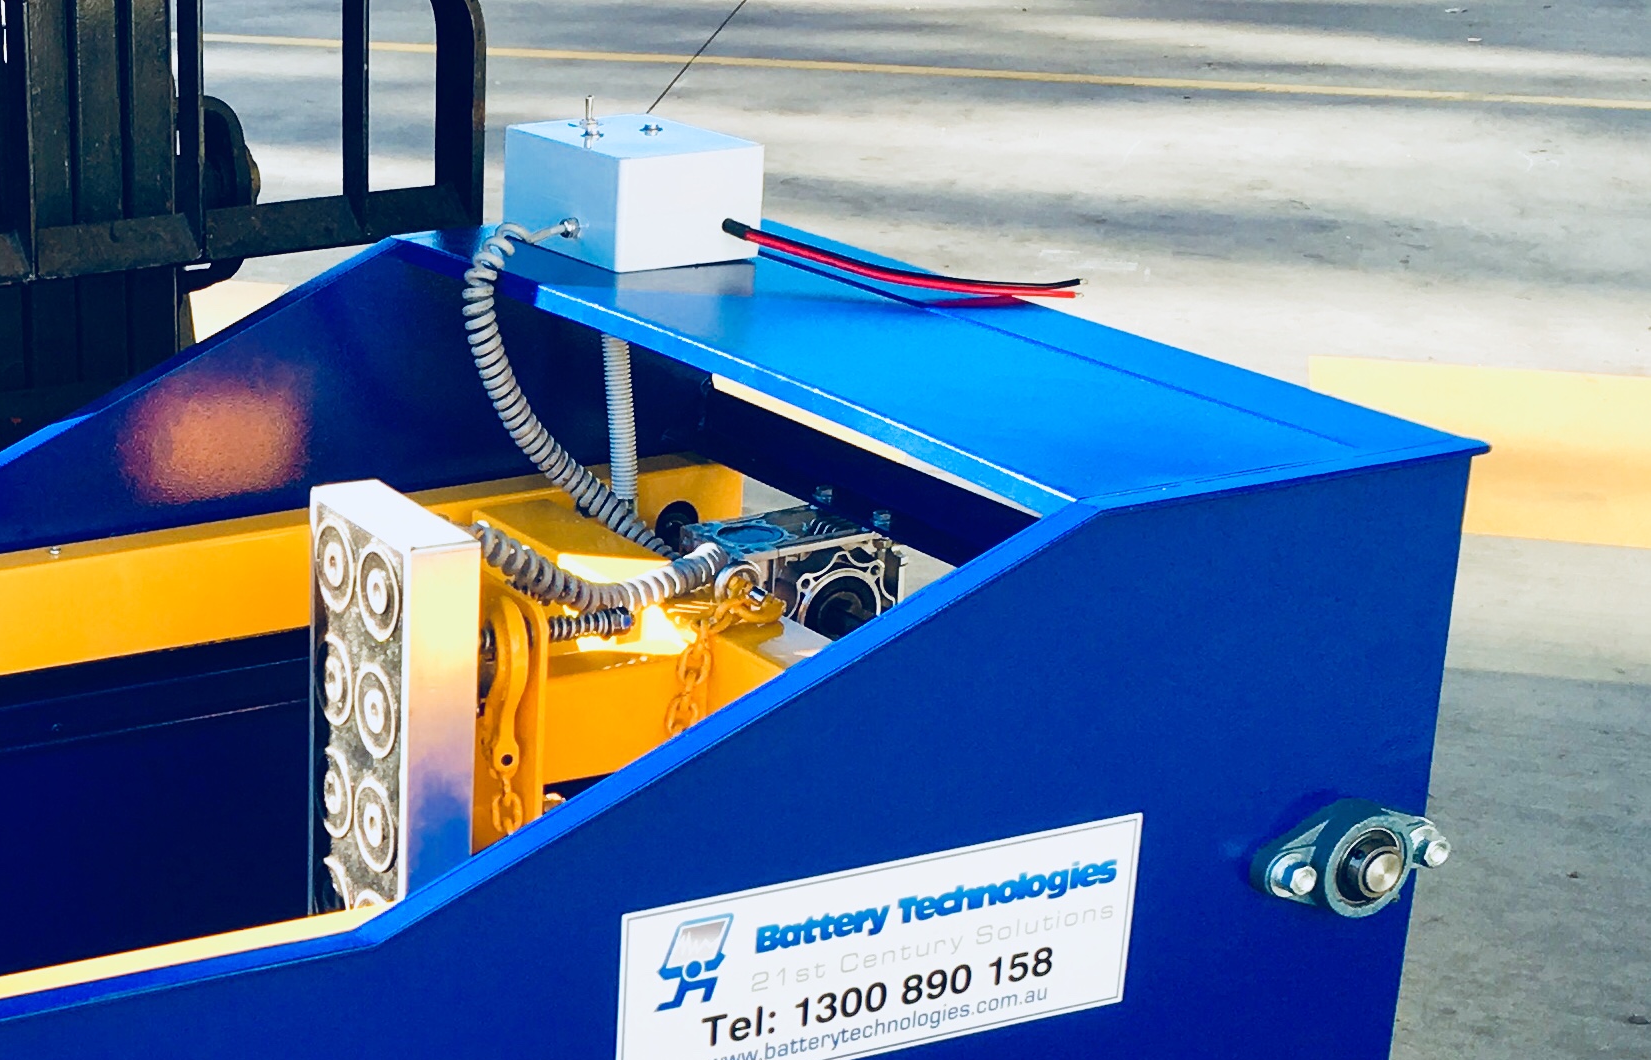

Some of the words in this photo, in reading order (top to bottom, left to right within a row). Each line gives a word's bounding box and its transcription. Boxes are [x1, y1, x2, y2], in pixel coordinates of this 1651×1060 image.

[751, 963, 826, 993] 21st
[840, 934, 964, 974] Century
[975, 904, 1114, 945] Solutions
[755, 904, 890, 954] Battery
[898, 858, 1118, 924] Technologies
[702, 1005, 777, 1047] Tel:
[795, 981, 887, 1027] 1300
[901, 963, 972, 1005] 890
[989, 946, 1053, 987] 158
